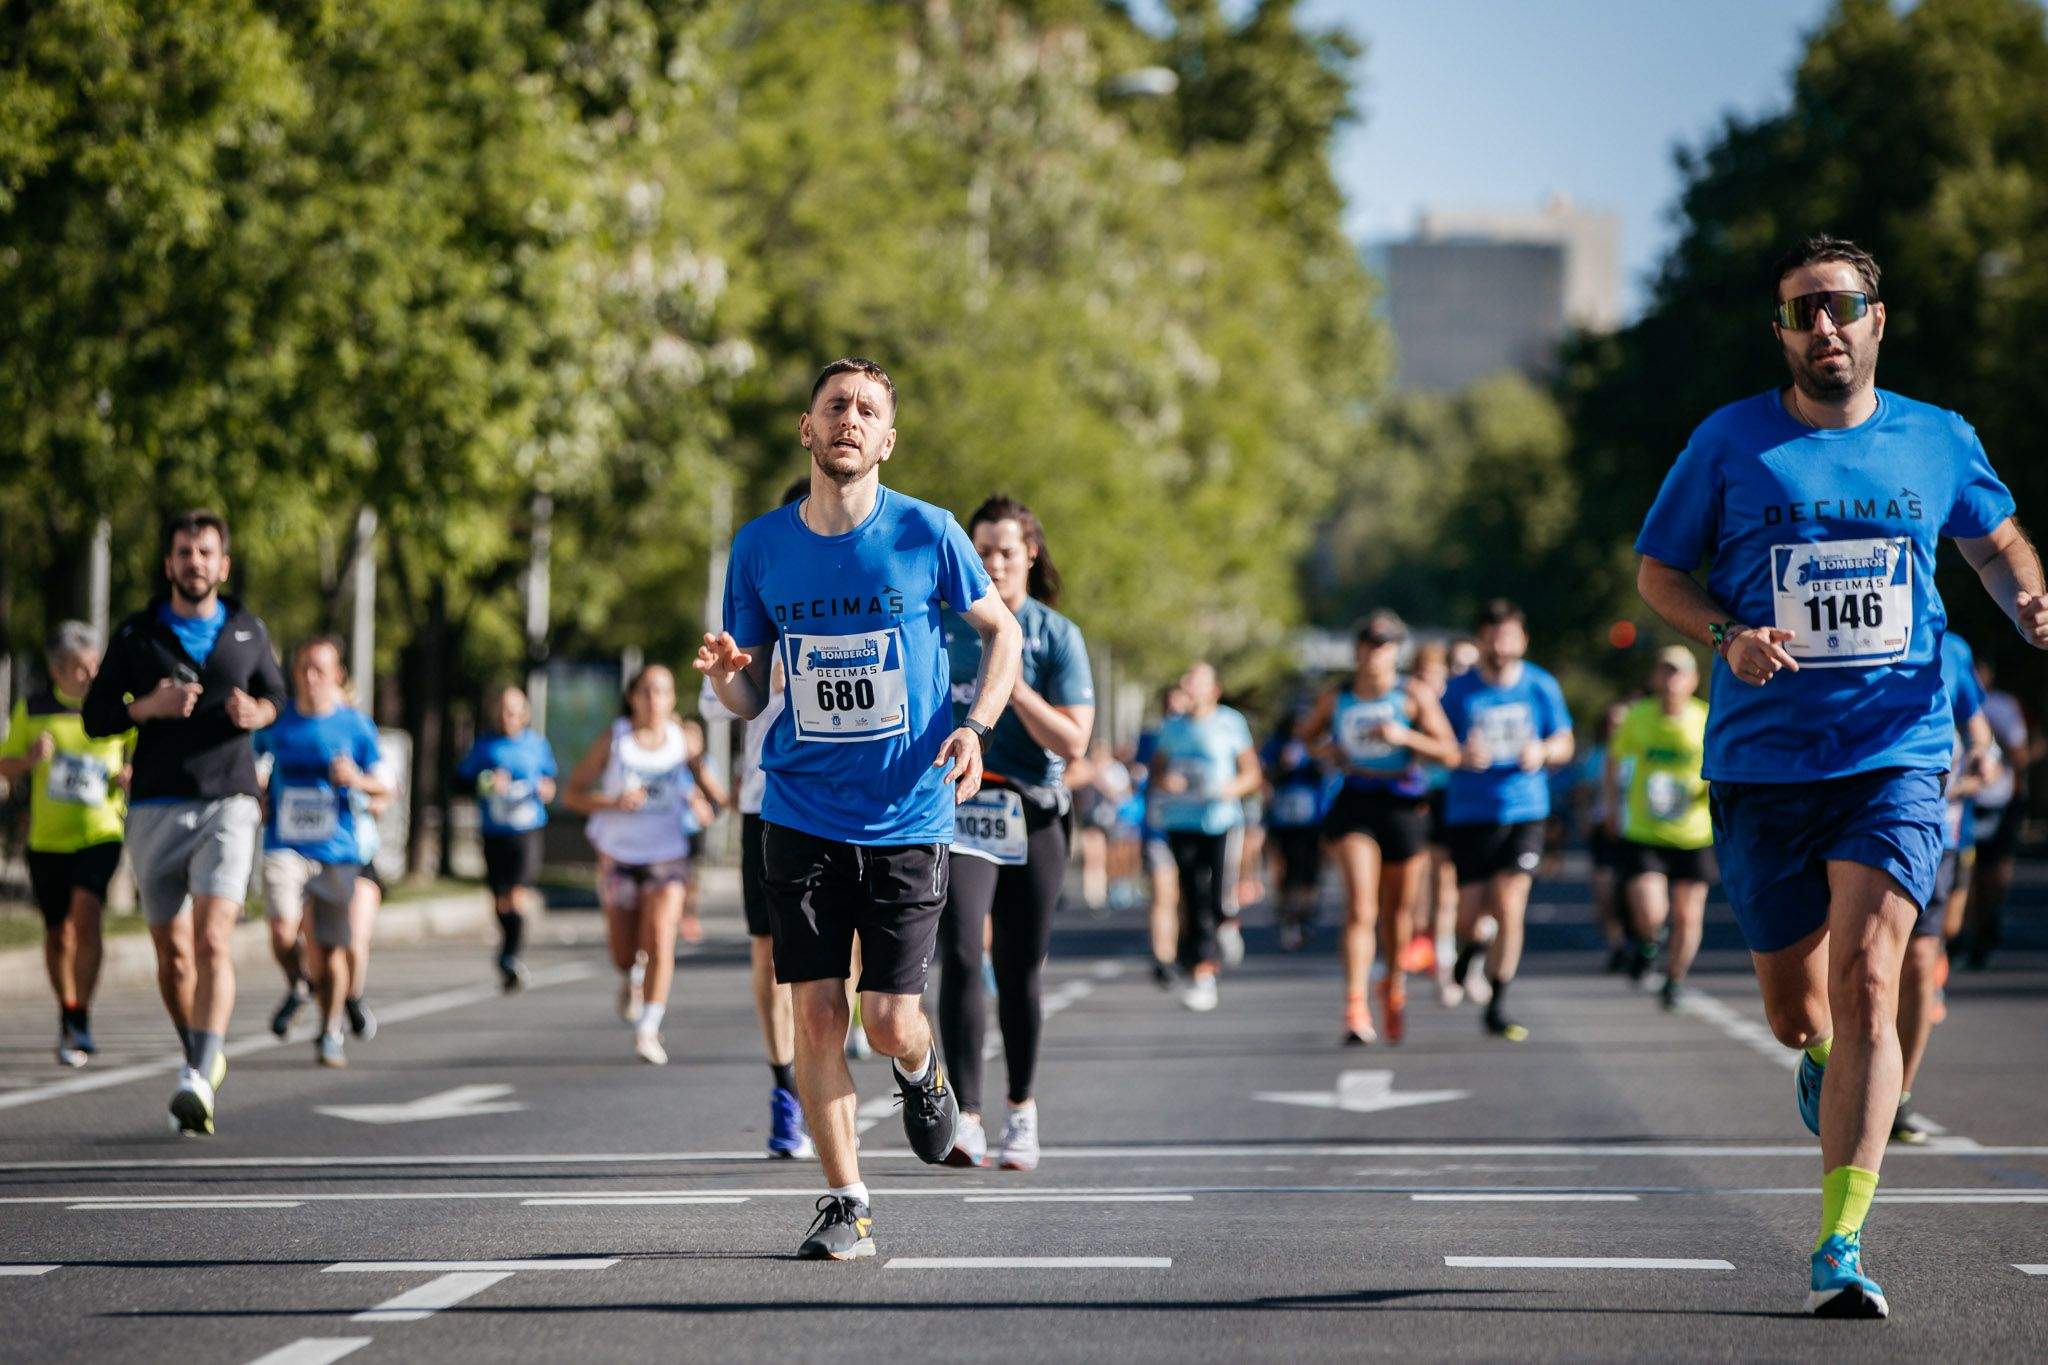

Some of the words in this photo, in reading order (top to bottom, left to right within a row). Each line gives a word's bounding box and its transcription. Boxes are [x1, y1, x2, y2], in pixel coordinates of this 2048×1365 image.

[1764, 500, 1922, 526] DECIMAS
[1818, 557, 1885, 570] BOMBEROS
[1812, 578, 1884, 592] DECIMAS
[774, 596, 904, 622] DECIMAS
[1804, 592, 1883, 631] 1146
[820, 648, 876, 660] BOMBEROS
[817, 666, 877, 677] DECIMAS
[816, 679, 875, 711] 680
[955, 817, 1006, 839] 1039
